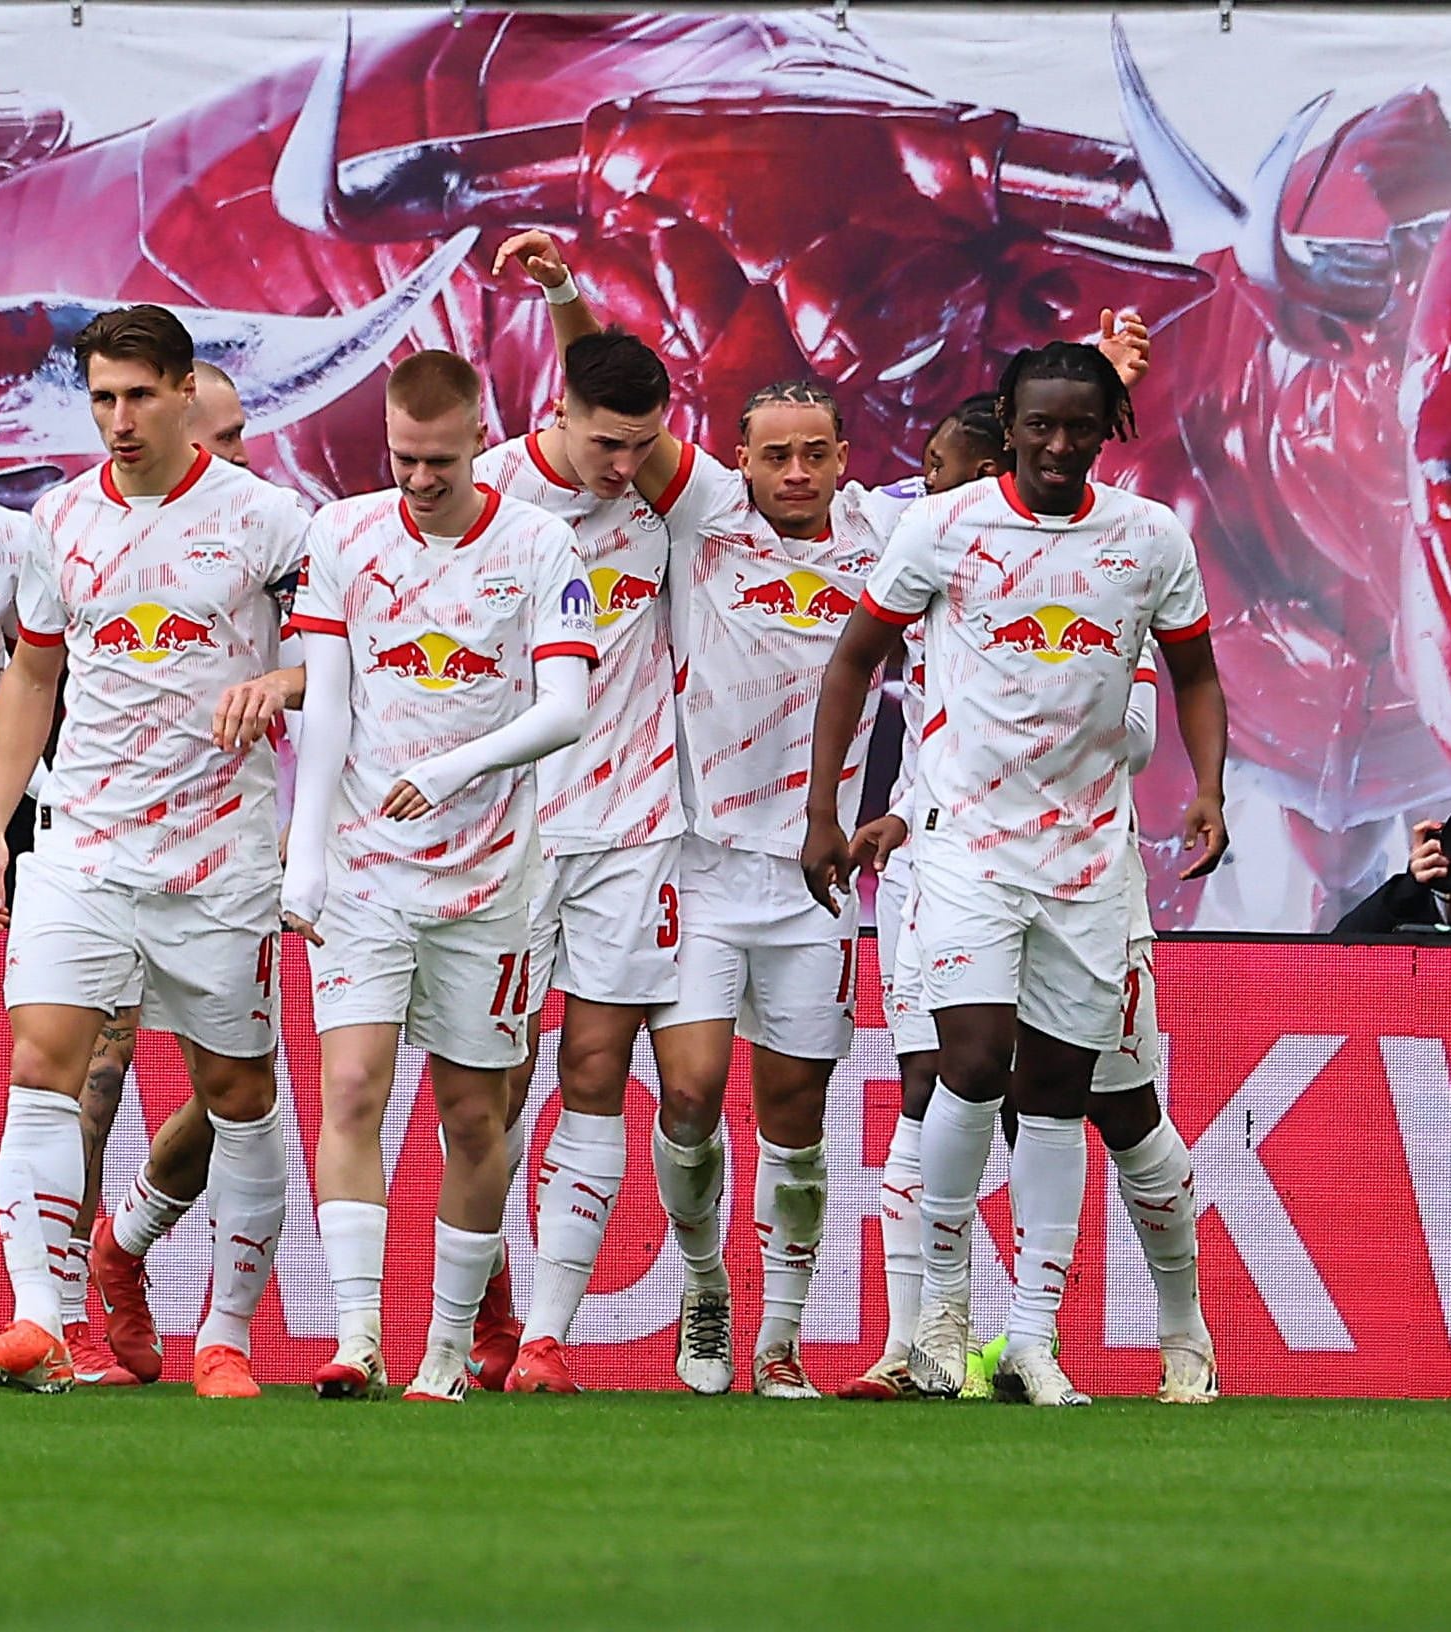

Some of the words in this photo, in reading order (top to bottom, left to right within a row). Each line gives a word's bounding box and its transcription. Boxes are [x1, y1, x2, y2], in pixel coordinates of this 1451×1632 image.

[656, 883, 679, 949] 3
[490, 949, 530, 1016] 18
[571, 1204, 599, 1222] RBL
[234, 1261, 257, 1273] RBL
